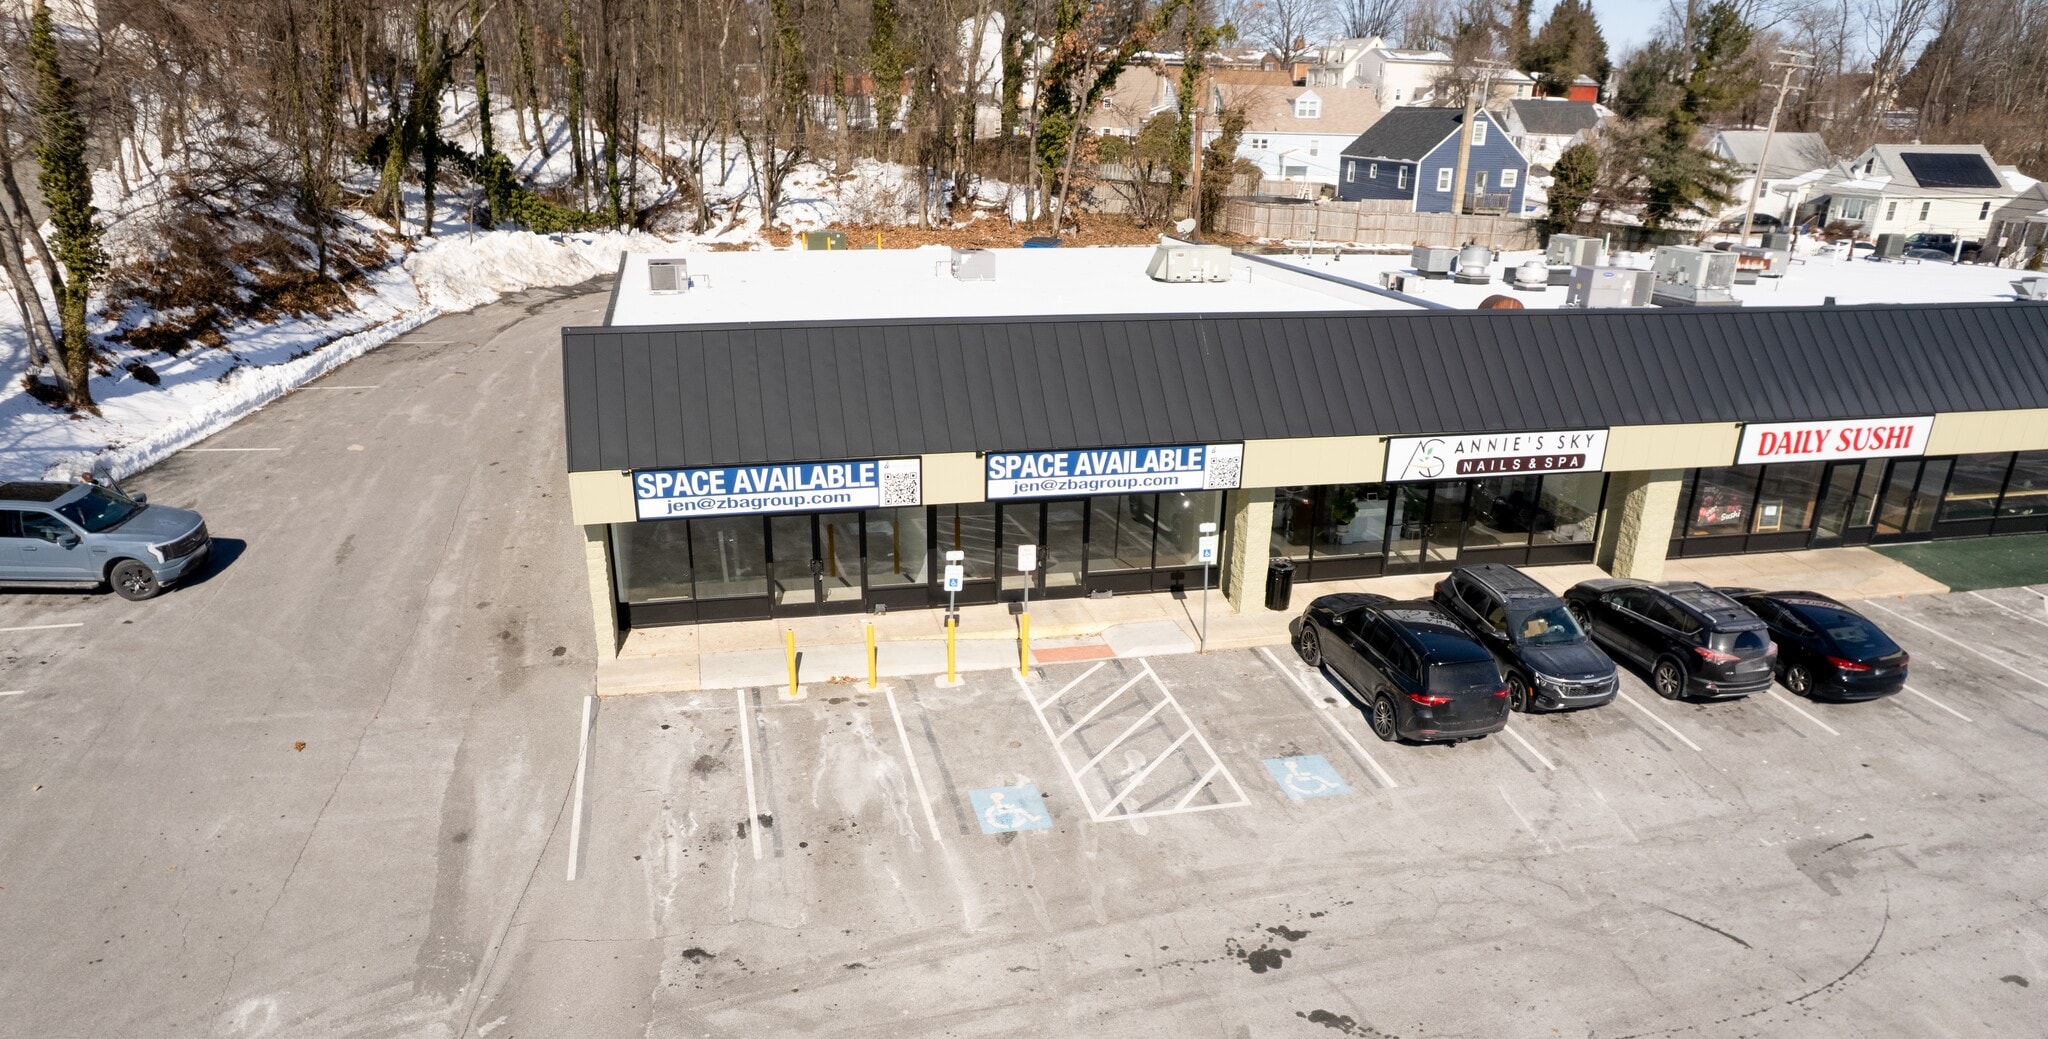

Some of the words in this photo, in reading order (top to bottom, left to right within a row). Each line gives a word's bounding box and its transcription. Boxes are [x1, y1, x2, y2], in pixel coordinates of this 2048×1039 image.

[1454, 435, 1545, 454] ANNIE'S
[1557, 433, 1595, 450] SKY
[1757, 429, 1832, 457] DAILY
[1835, 425, 1914, 453] SUSHI
[989, 454, 1068, 480] SPACE
[1074, 448, 1202, 475] AVAILABLE
[1462, 458, 1522, 473] NAILS
[1527, 457, 1538, 469] &
[1544, 455, 1579, 469] SPA
[637, 470, 726, 499] SPACE
[733, 464, 875, 493] AVAILABLE
[1013, 475, 1178, 494] jen@zbagroup.com
[666, 492, 850, 514] jen@zbagroup.com
